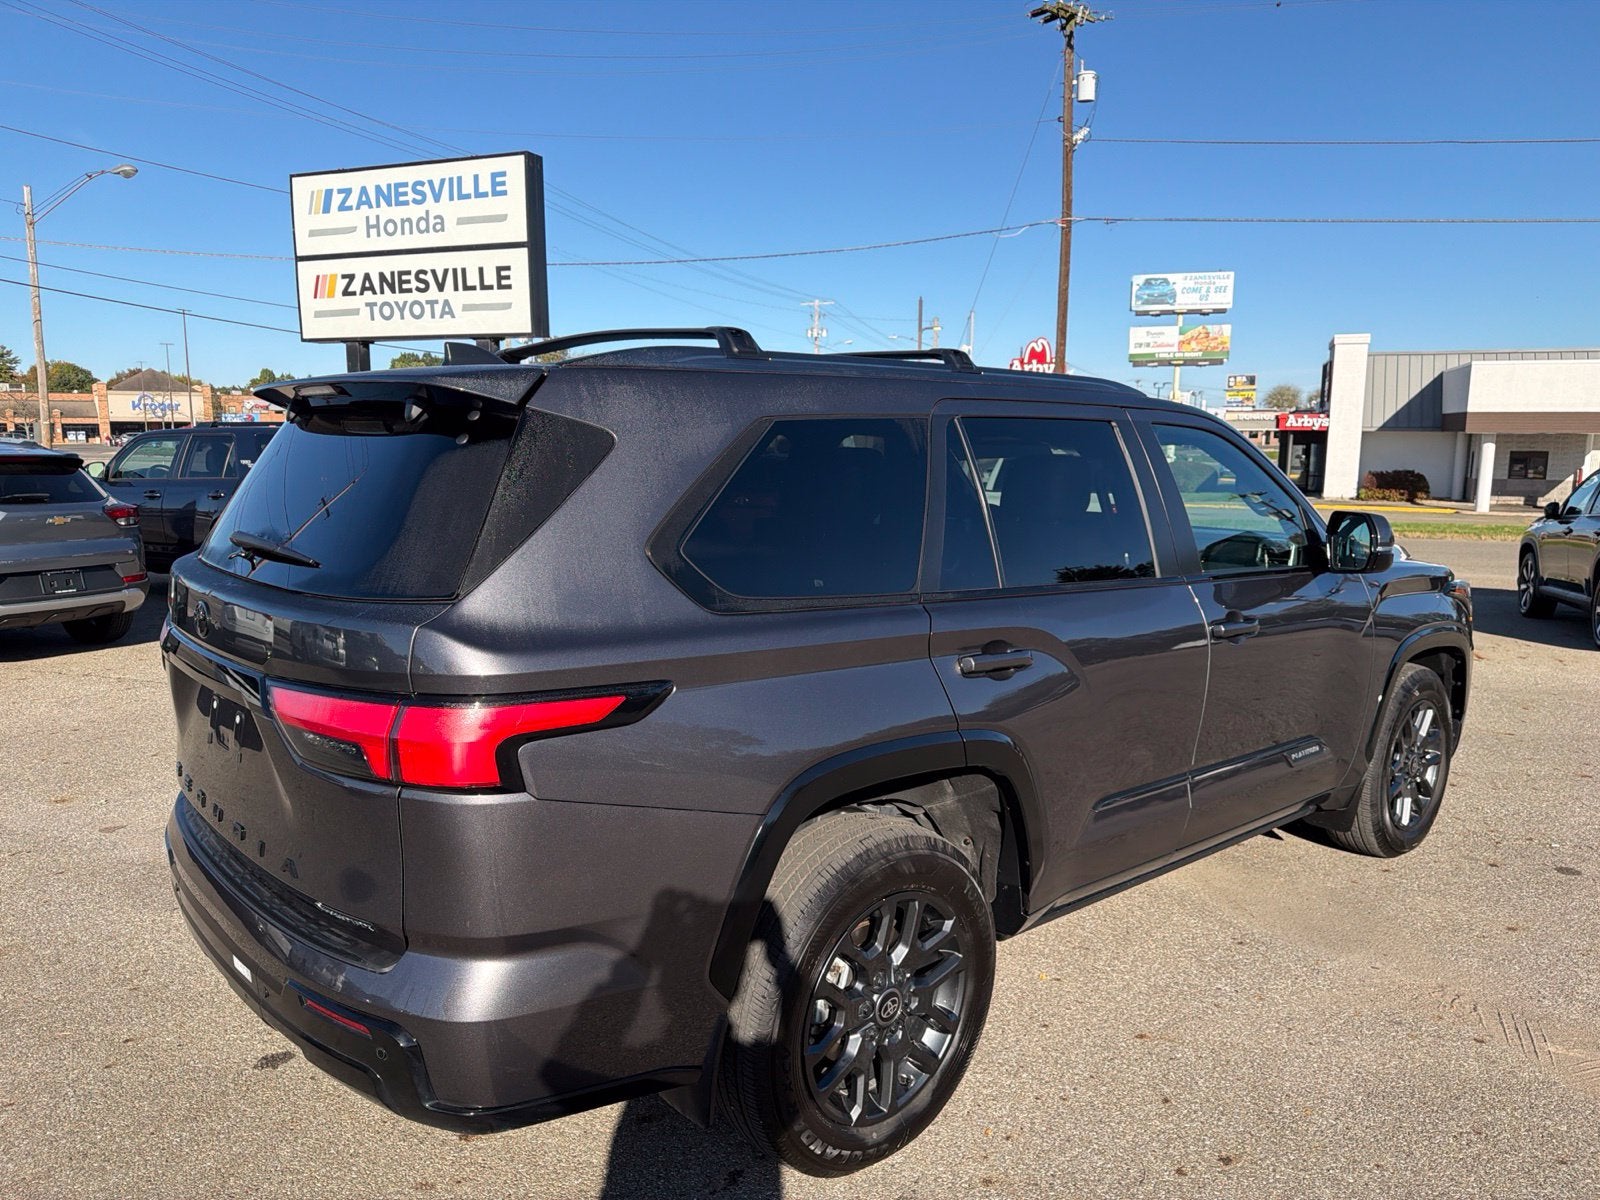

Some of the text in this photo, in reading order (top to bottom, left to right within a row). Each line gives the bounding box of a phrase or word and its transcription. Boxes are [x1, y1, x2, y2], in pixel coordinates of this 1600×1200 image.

[337, 171, 508, 212] ZANESVILLE
[365, 209, 445, 239] Honda
[341, 265, 512, 297] ZANESVILLE
[1181, 286, 1203, 294] COME
[1214, 285, 1228, 294] SEE
[1199, 293, 1210, 301] US
[365, 298, 456, 322] TOYOTA
[1285, 414, 1330, 430] Arby's
